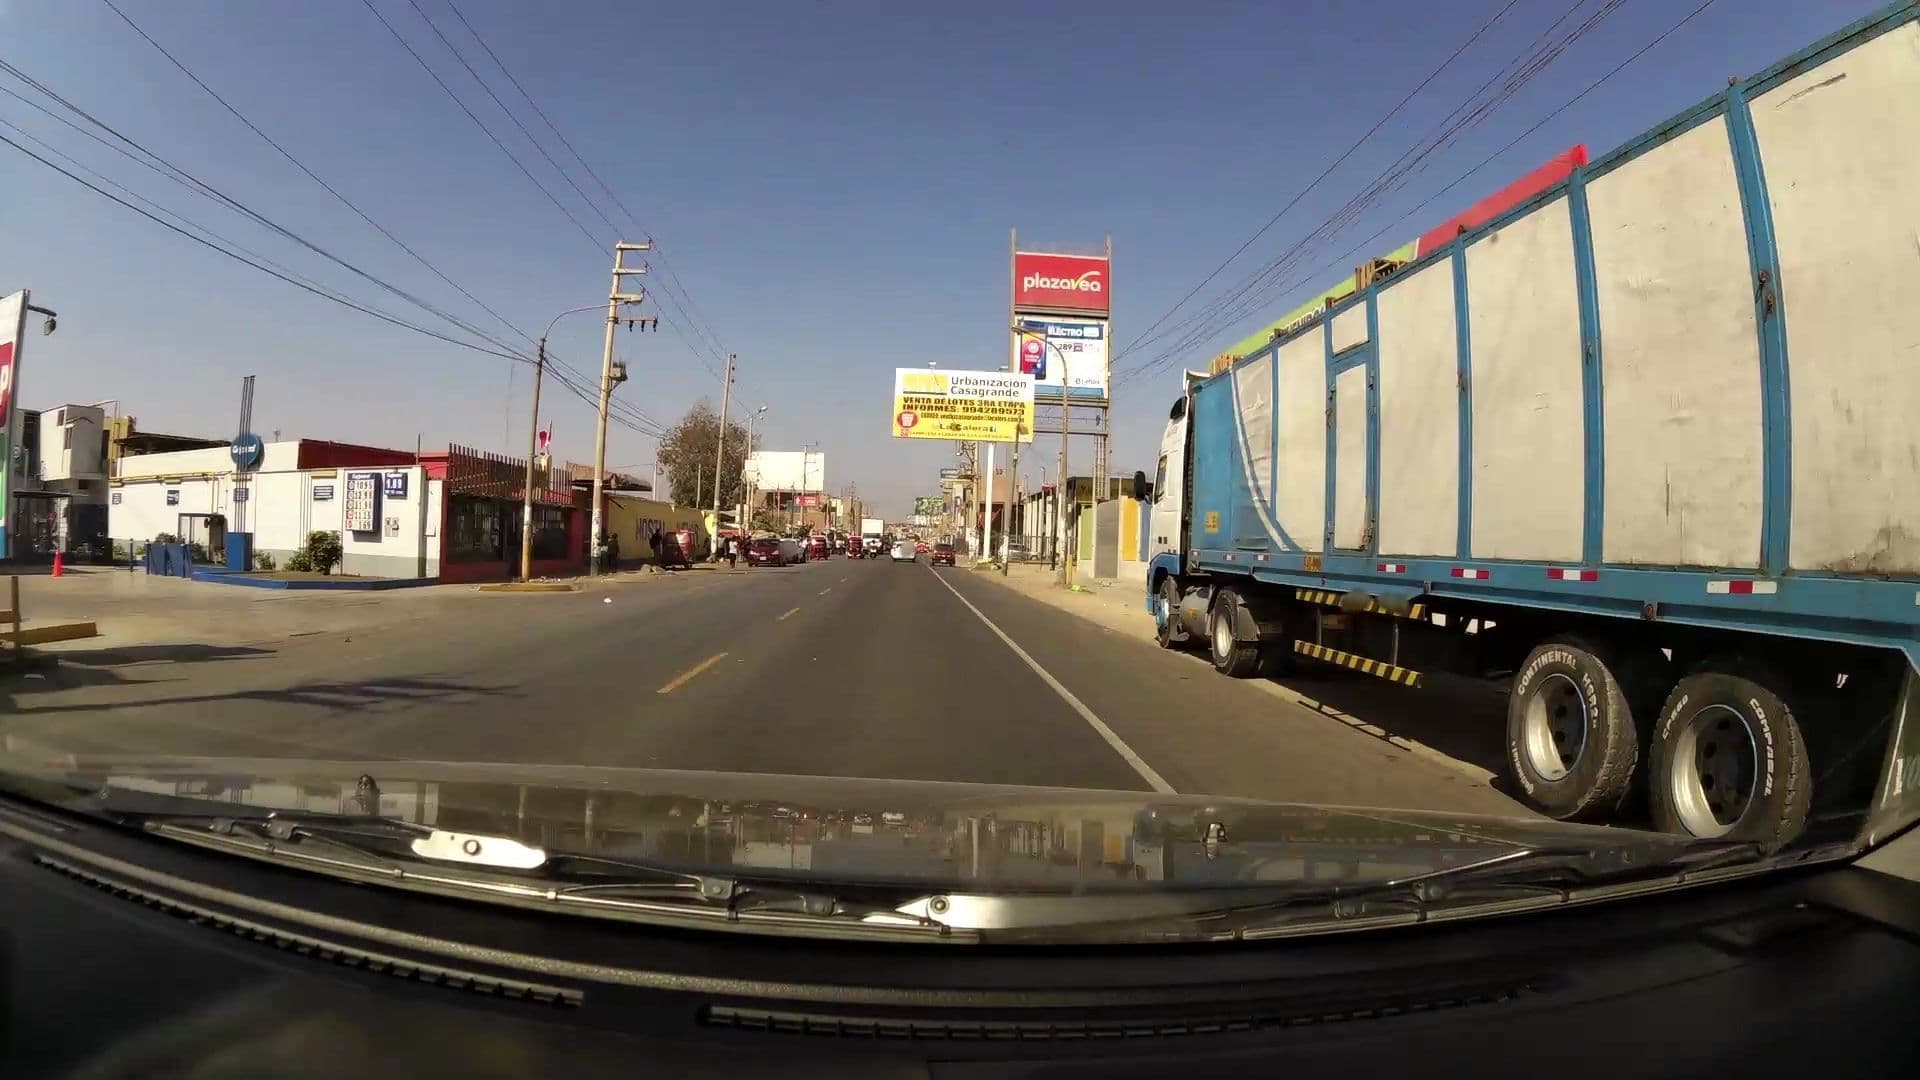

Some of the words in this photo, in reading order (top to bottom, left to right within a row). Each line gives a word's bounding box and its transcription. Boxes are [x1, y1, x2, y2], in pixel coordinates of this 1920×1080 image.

[950, 385, 1020, 398] Casagrande
[903, 396, 932, 404] VENTA
[948, 398, 975, 406] LOTES
[998, 400, 1026, 408] ETAPA
[1517, 649, 1577, 696] CONTINENTAL
